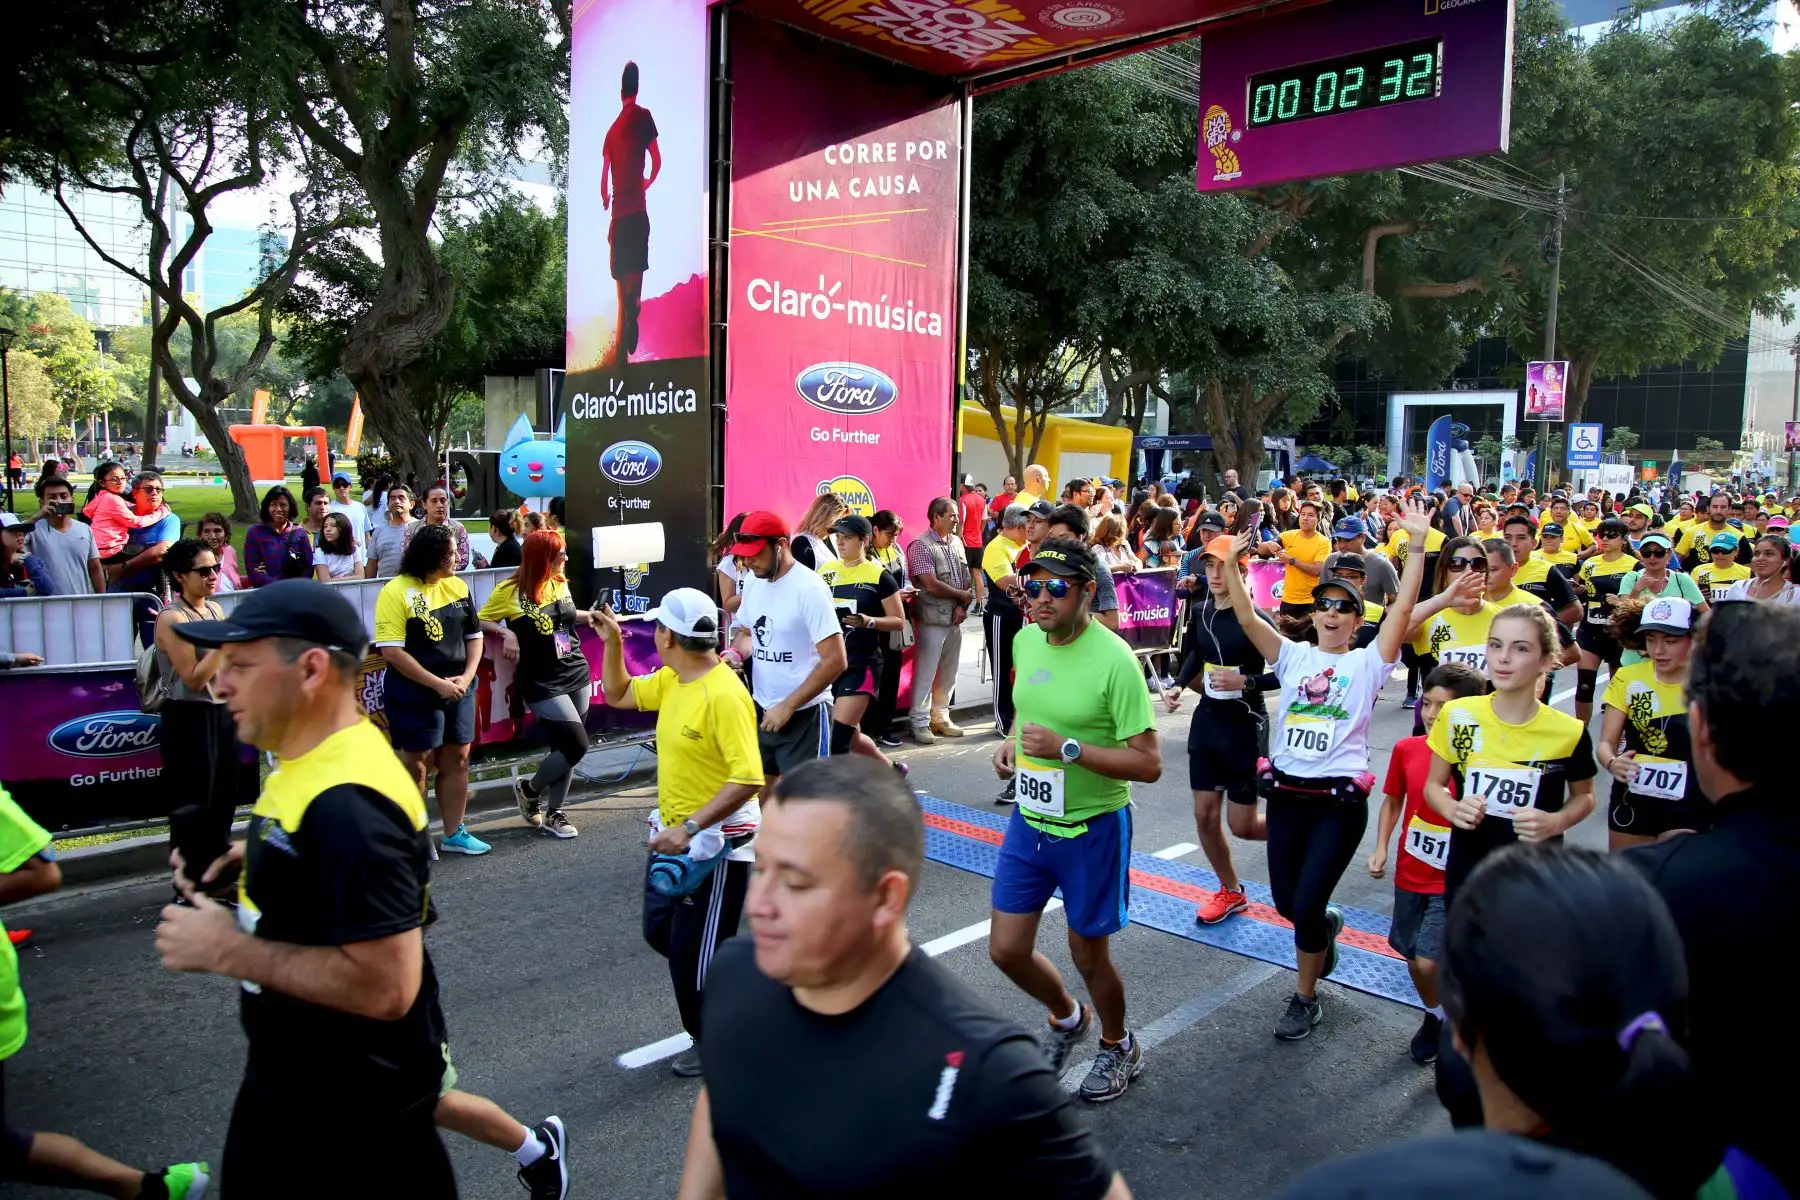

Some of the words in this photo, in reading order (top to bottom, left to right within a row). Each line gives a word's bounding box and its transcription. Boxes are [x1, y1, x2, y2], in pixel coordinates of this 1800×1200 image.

[853, 0, 951, 29] NA
[893, 7, 987, 46] GEO
[931, 18, 1039, 60] RUN
[1252, 78, 1301, 123] 00
[1313, 66, 1365, 113] 02
[1379, 53, 1432, 101] 32
[1206, 122, 1226, 139] GEO
[1208, 112, 1226, 131] NAT
[824, 143, 897, 165] CORRE
[906, 140, 948, 161] POR
[1207, 131, 1228, 149] RUN
[789, 179, 840, 203] UNA
[848, 173, 921, 199] CAUSA
[816, 368, 879, 407] Ford
[810, 426, 830, 442] Go
[832, 428, 881, 445] Further
[611, 448, 649, 477] Ford
[1431, 440, 1447, 477] Ford
[612, 589, 650, 613] SORT
[366, 667, 387, 689] NA
[362, 685, 384, 701] GE
[1631, 690, 1654, 704] NAT
[366, 699, 385, 714] RU
[76, 718, 157, 751] Ford
[1287, 727, 1329, 752] 1706
[1453, 724, 1479, 738] NAT
[70, 773, 96, 787] Go
[99, 766, 163, 784] Further
[1020, 772, 1052, 804] 598
[1470, 771, 1533, 808] 1785
